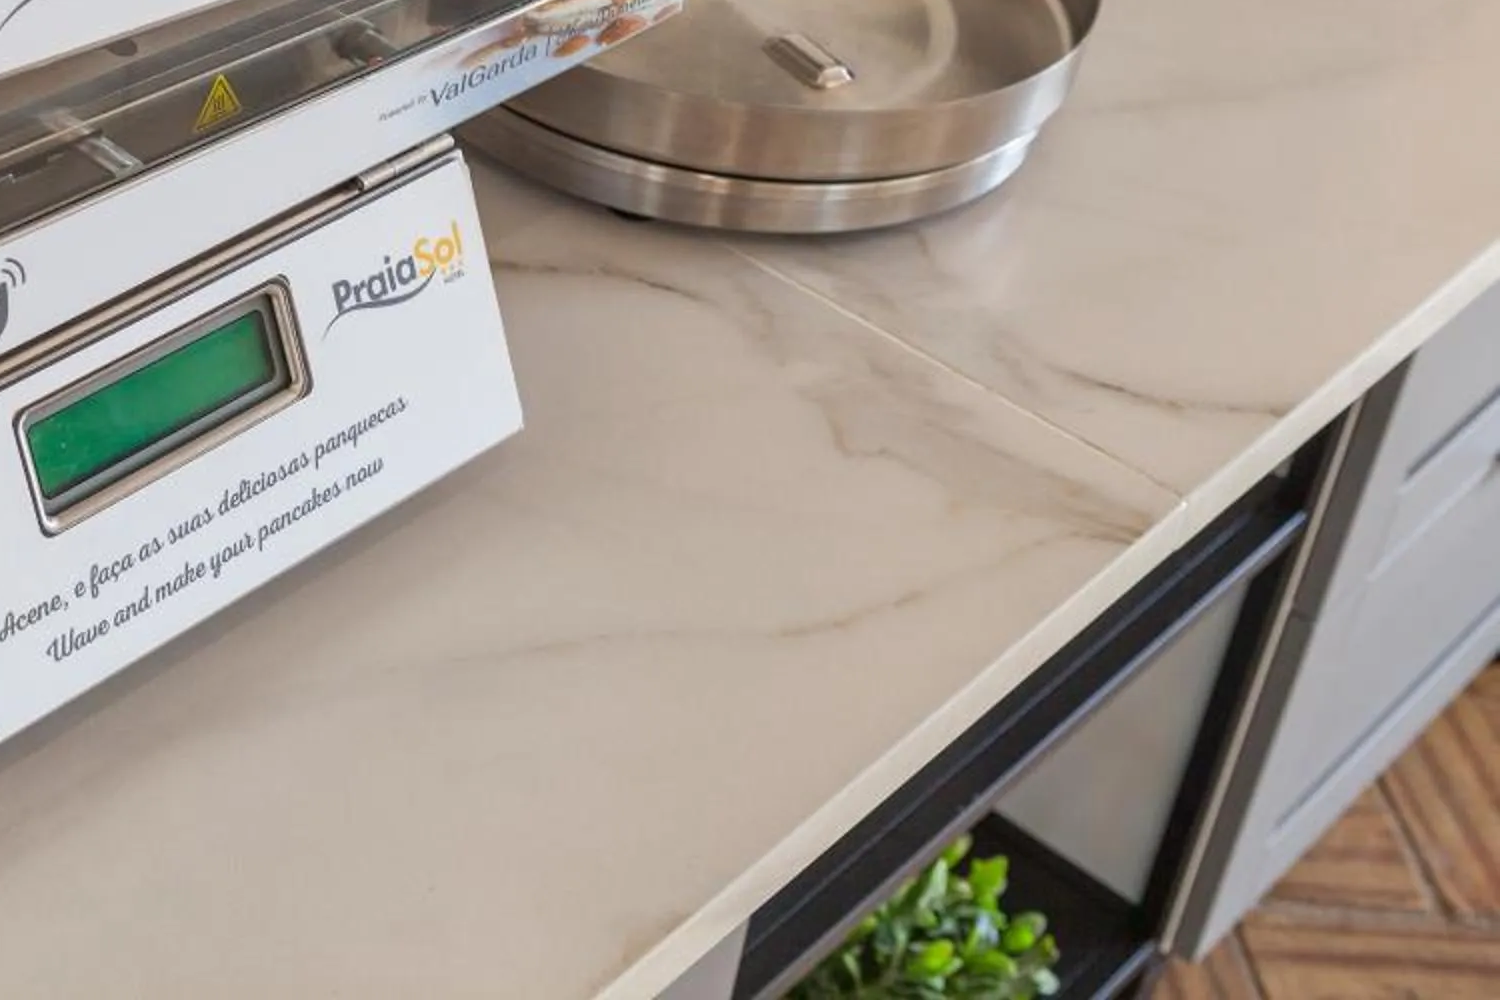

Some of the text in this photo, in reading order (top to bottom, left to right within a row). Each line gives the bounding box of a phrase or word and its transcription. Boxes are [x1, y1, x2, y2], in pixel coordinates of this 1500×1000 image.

[430, 41, 538, 106] ValGarda
[332, 218, 462, 313] PraiaSol
[46, 456, 386, 664] Wave and make your pancakes now
[74, 580, 87, 598] e
[89, 556, 136, 601] faça
[138, 536, 164, 563] as
[167, 507, 216, 547] suas
[218, 453, 311, 520] deliciosas
[313, 396, 410, 470] panquecas
